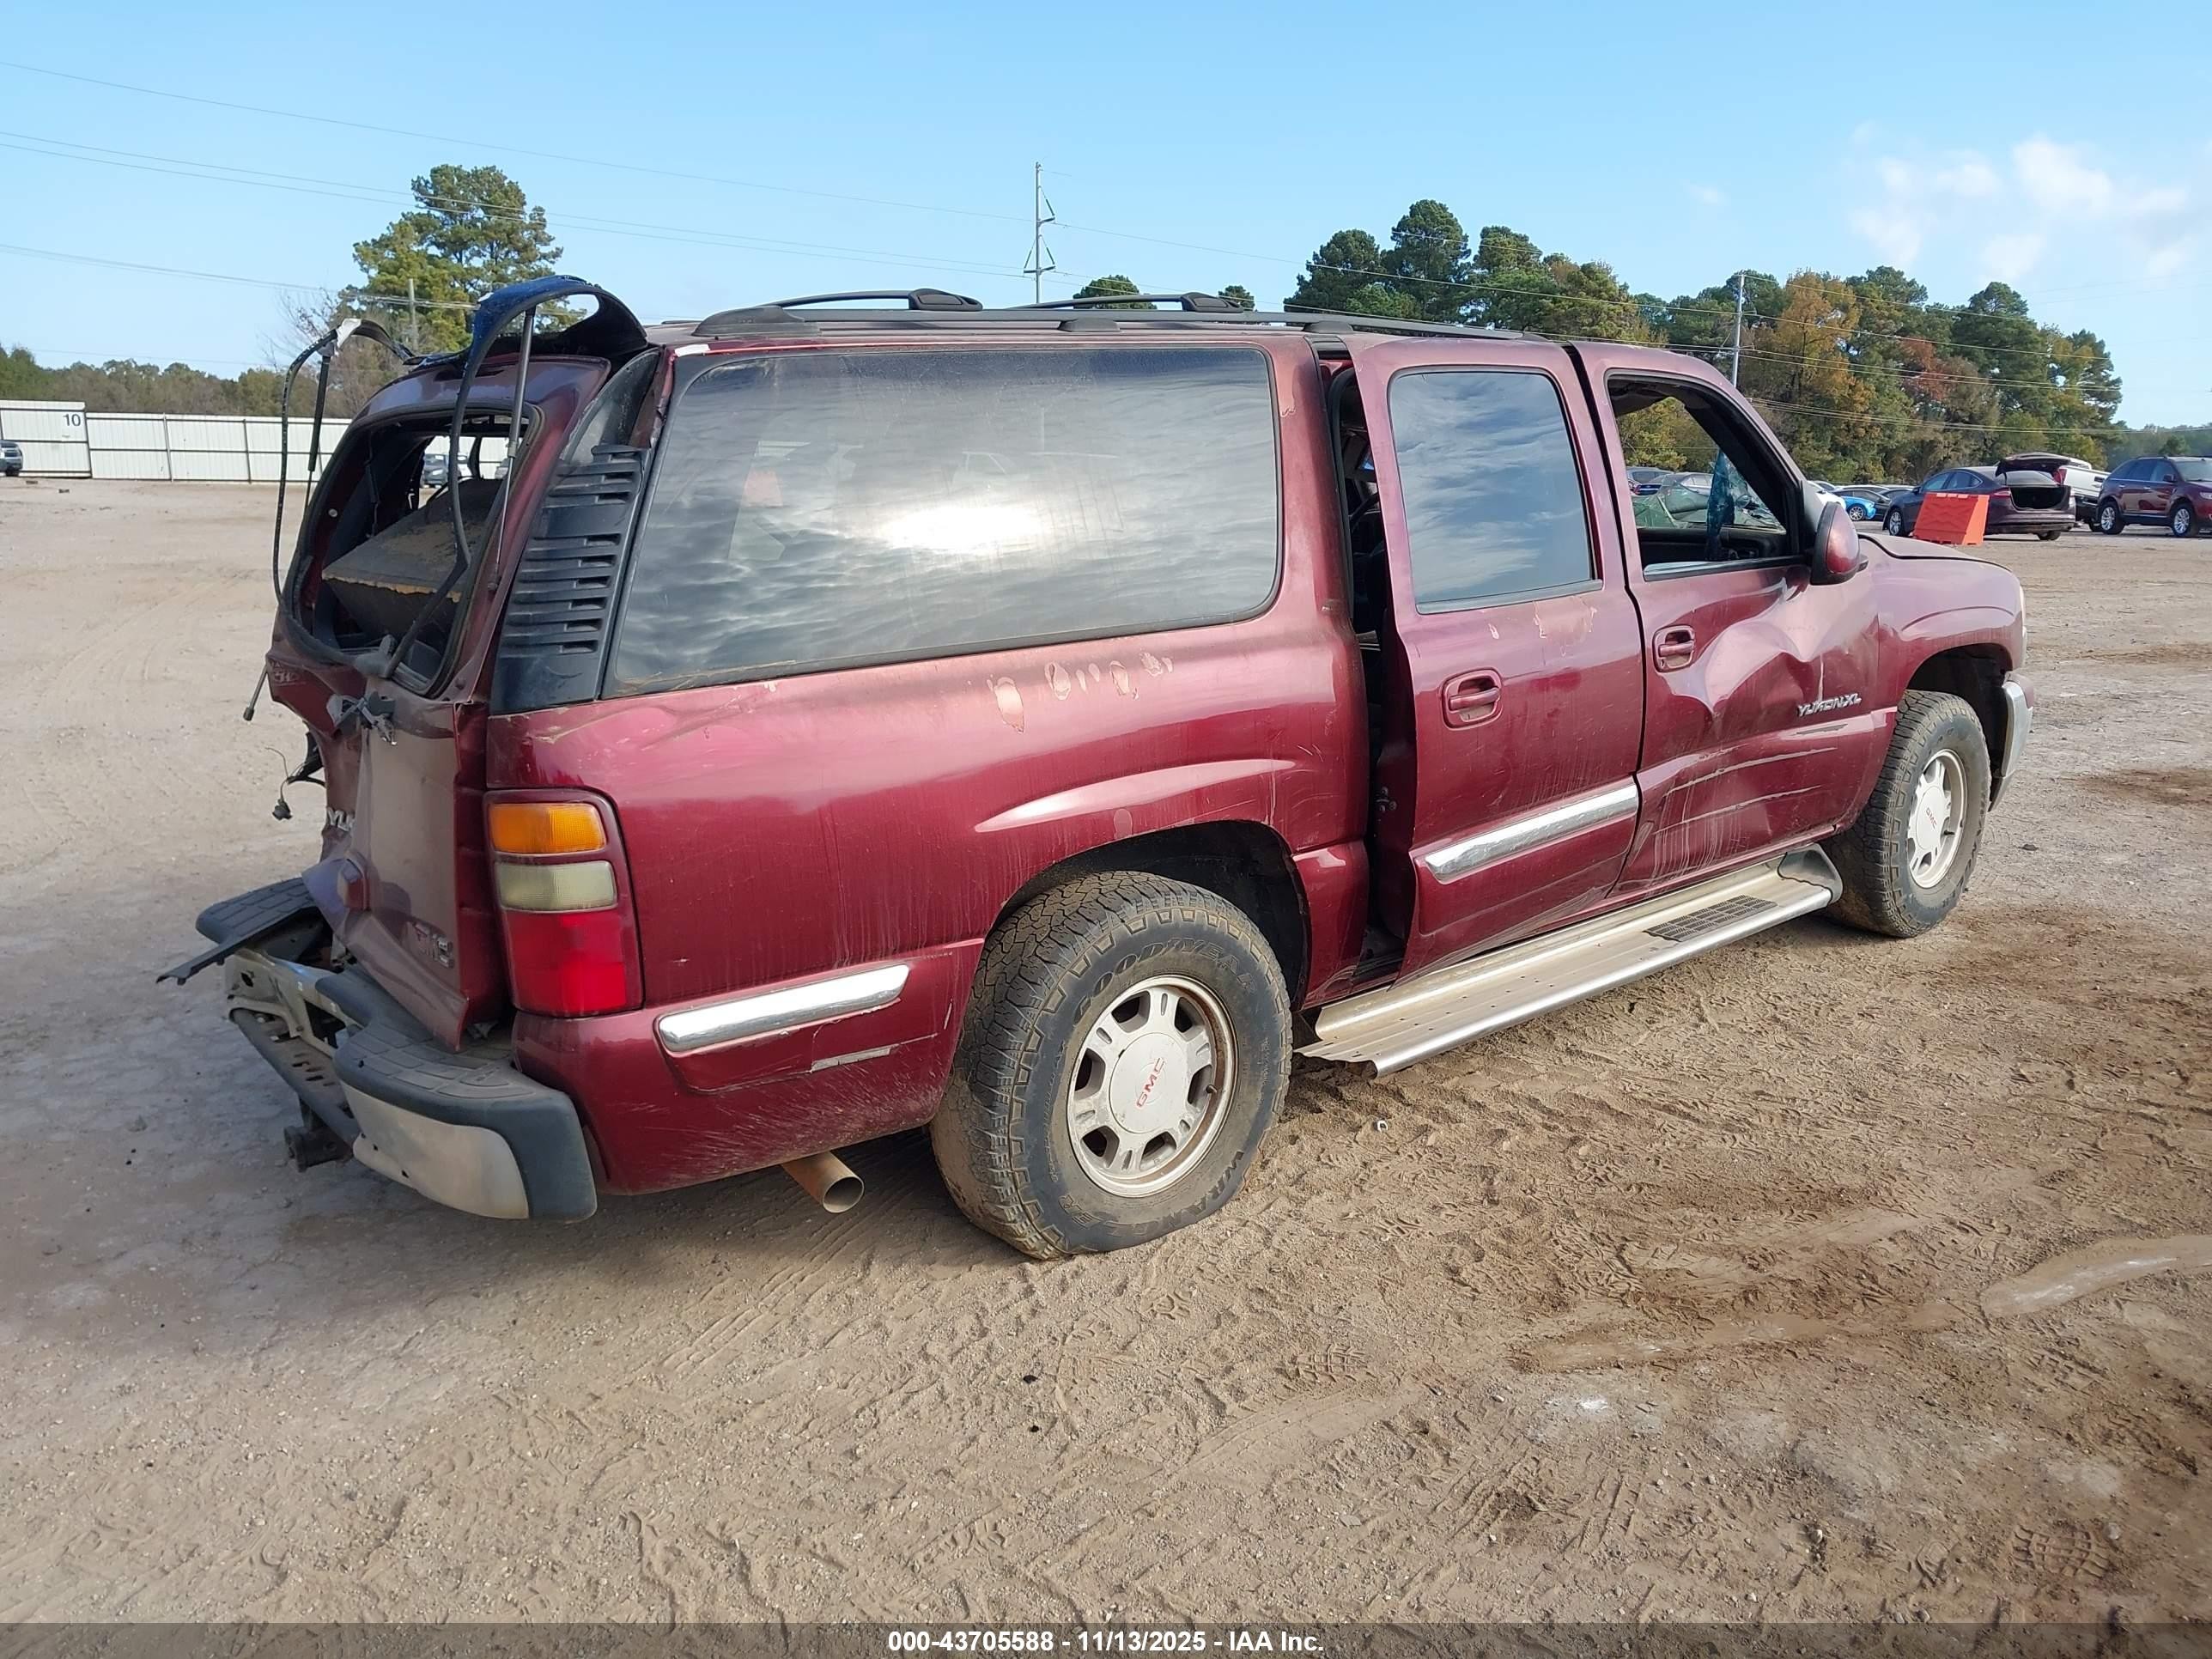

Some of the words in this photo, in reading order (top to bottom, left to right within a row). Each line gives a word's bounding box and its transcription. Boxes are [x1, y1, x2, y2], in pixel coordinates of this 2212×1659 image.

[63, 413, 82, 427] 10
[1797, 696, 1844, 717] YUKON
[1073, 937, 1257, 1026] GOODYEAR
[1133, 1056, 1168, 1110] GMC
